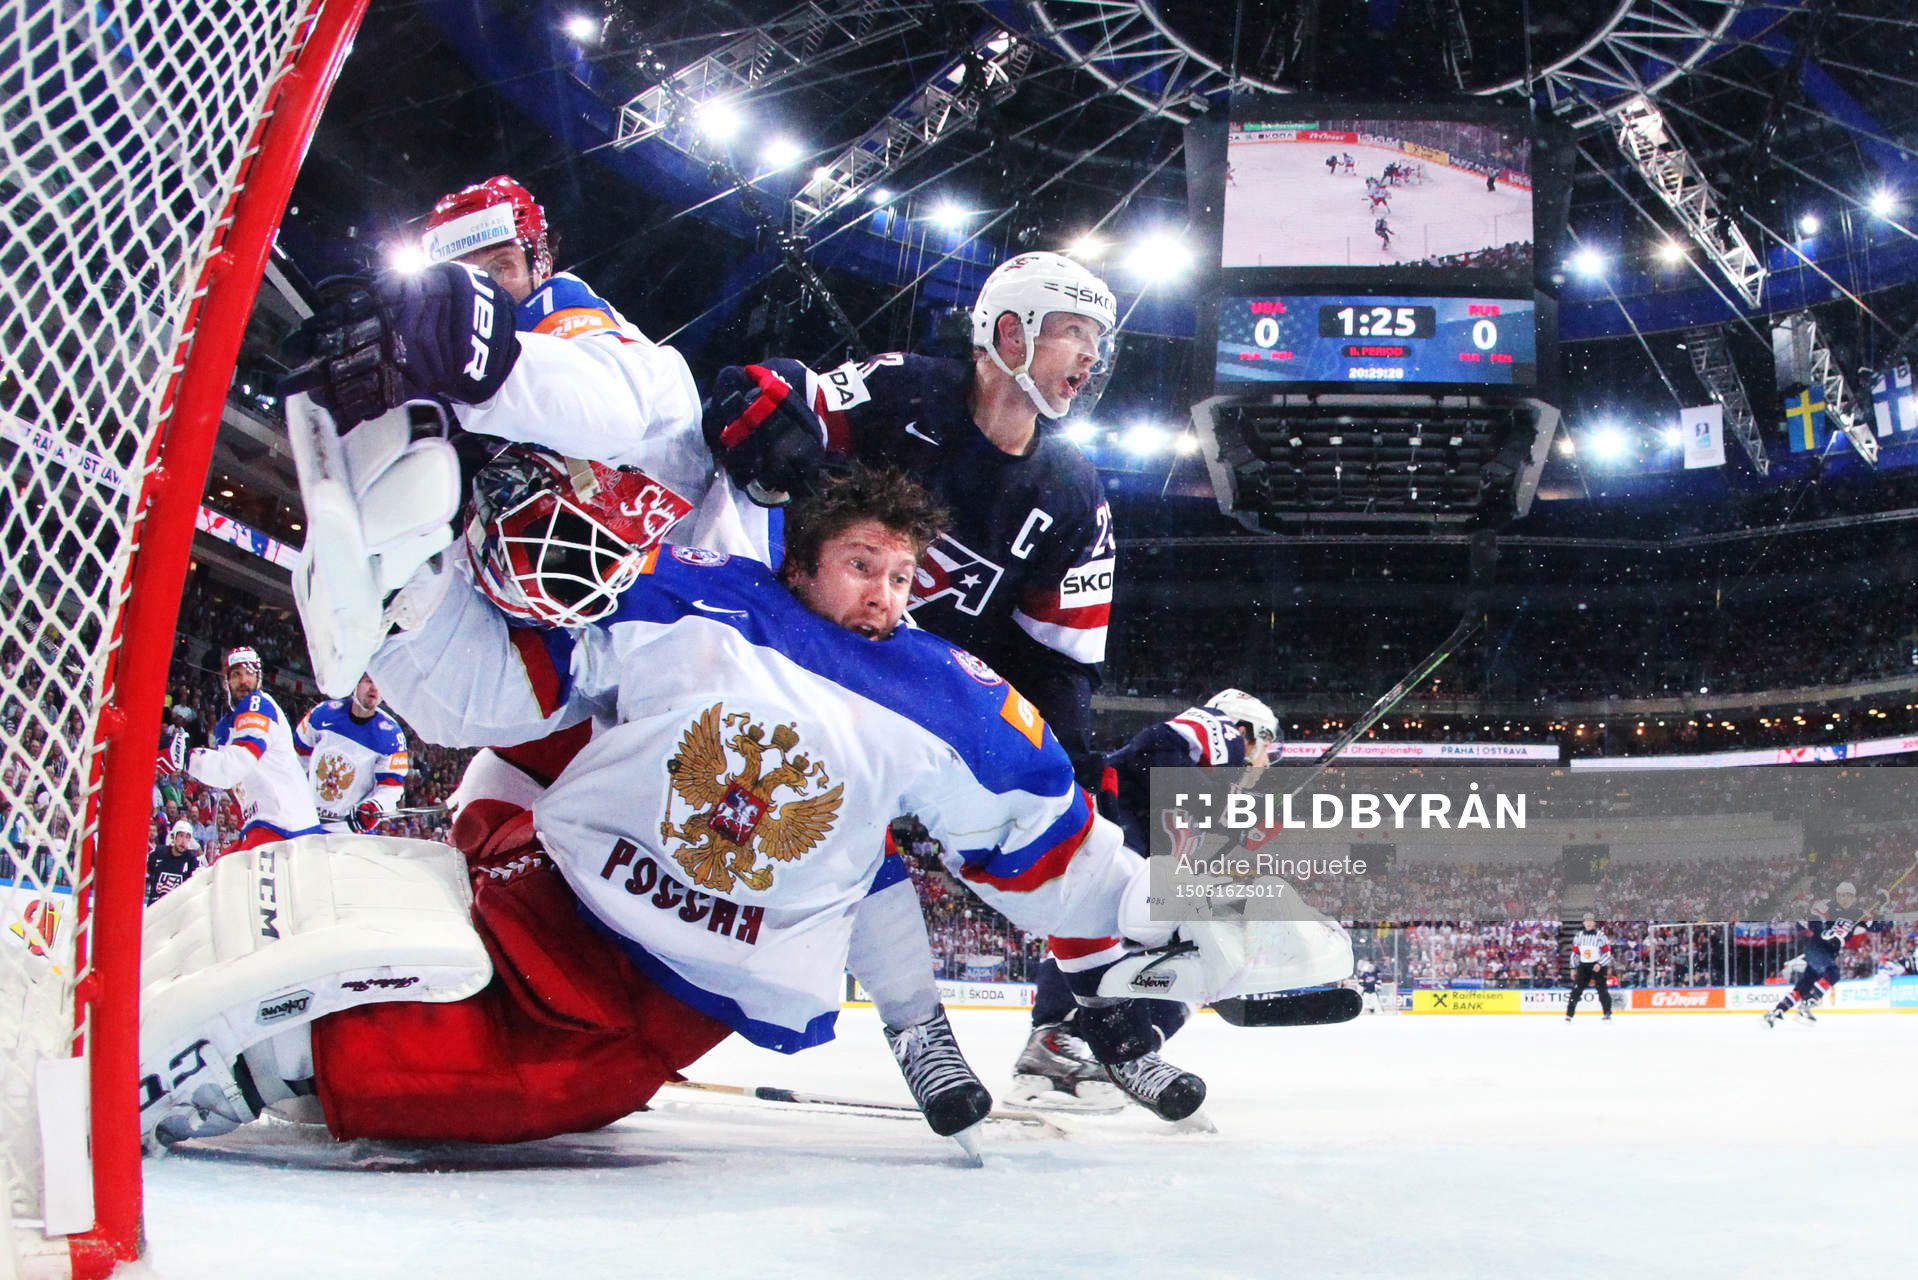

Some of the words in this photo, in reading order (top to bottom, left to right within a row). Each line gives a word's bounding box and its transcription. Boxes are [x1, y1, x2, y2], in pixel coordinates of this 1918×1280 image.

[1337, 307, 1416, 337] 1:25
[1254, 317, 1279, 348] 0
[1472, 319, 1497, 350] 0
[1010, 508, 1054, 560] C
[1351, 746, 1424, 756] Championship
[1441, 746, 1475, 755] PRAHA
[1482, 747, 1528, 756] OSTRAVA
[969, 989, 1005, 1000] ŠKODA
[1452, 1002, 1483, 1010] BANK
